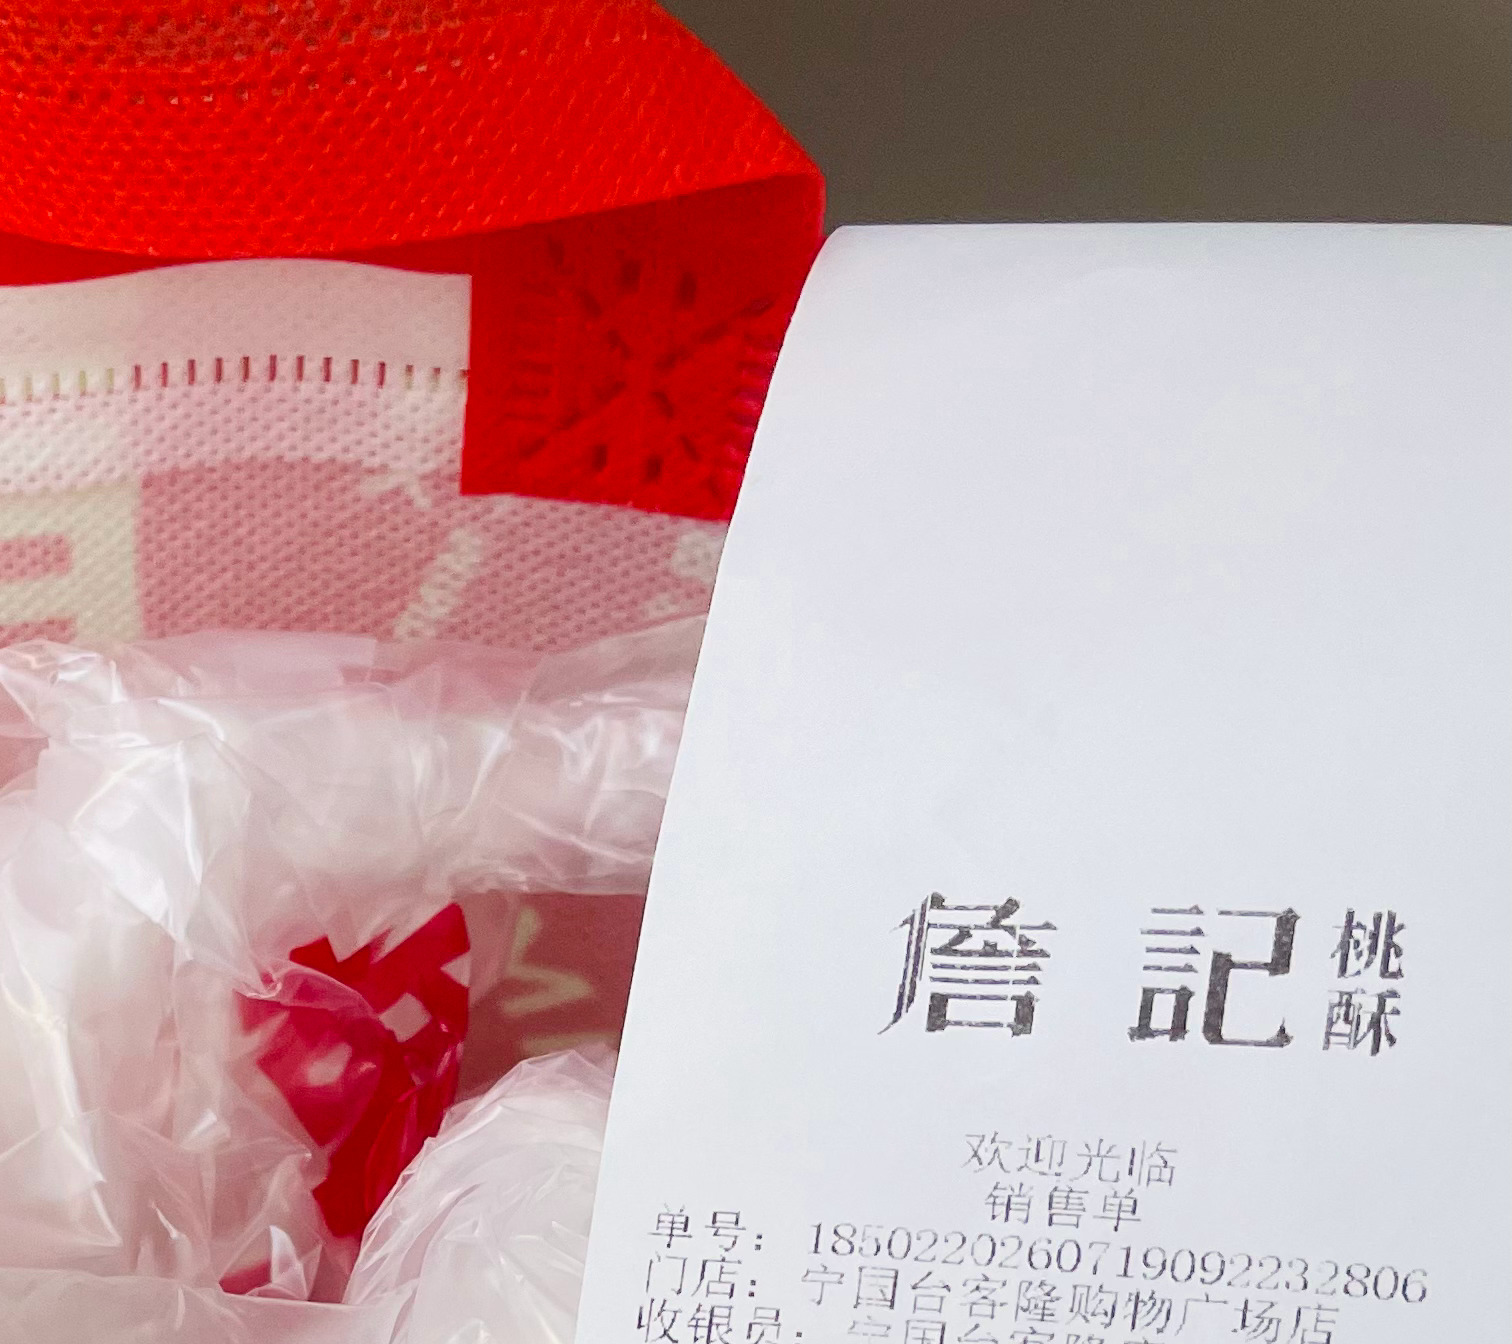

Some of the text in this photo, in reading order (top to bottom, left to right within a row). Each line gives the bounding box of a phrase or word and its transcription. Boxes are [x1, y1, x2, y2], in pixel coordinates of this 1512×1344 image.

[962, 1131, 1178, 1187] 欢迎光临
[985, 1181, 1142, 1232] 销售单
